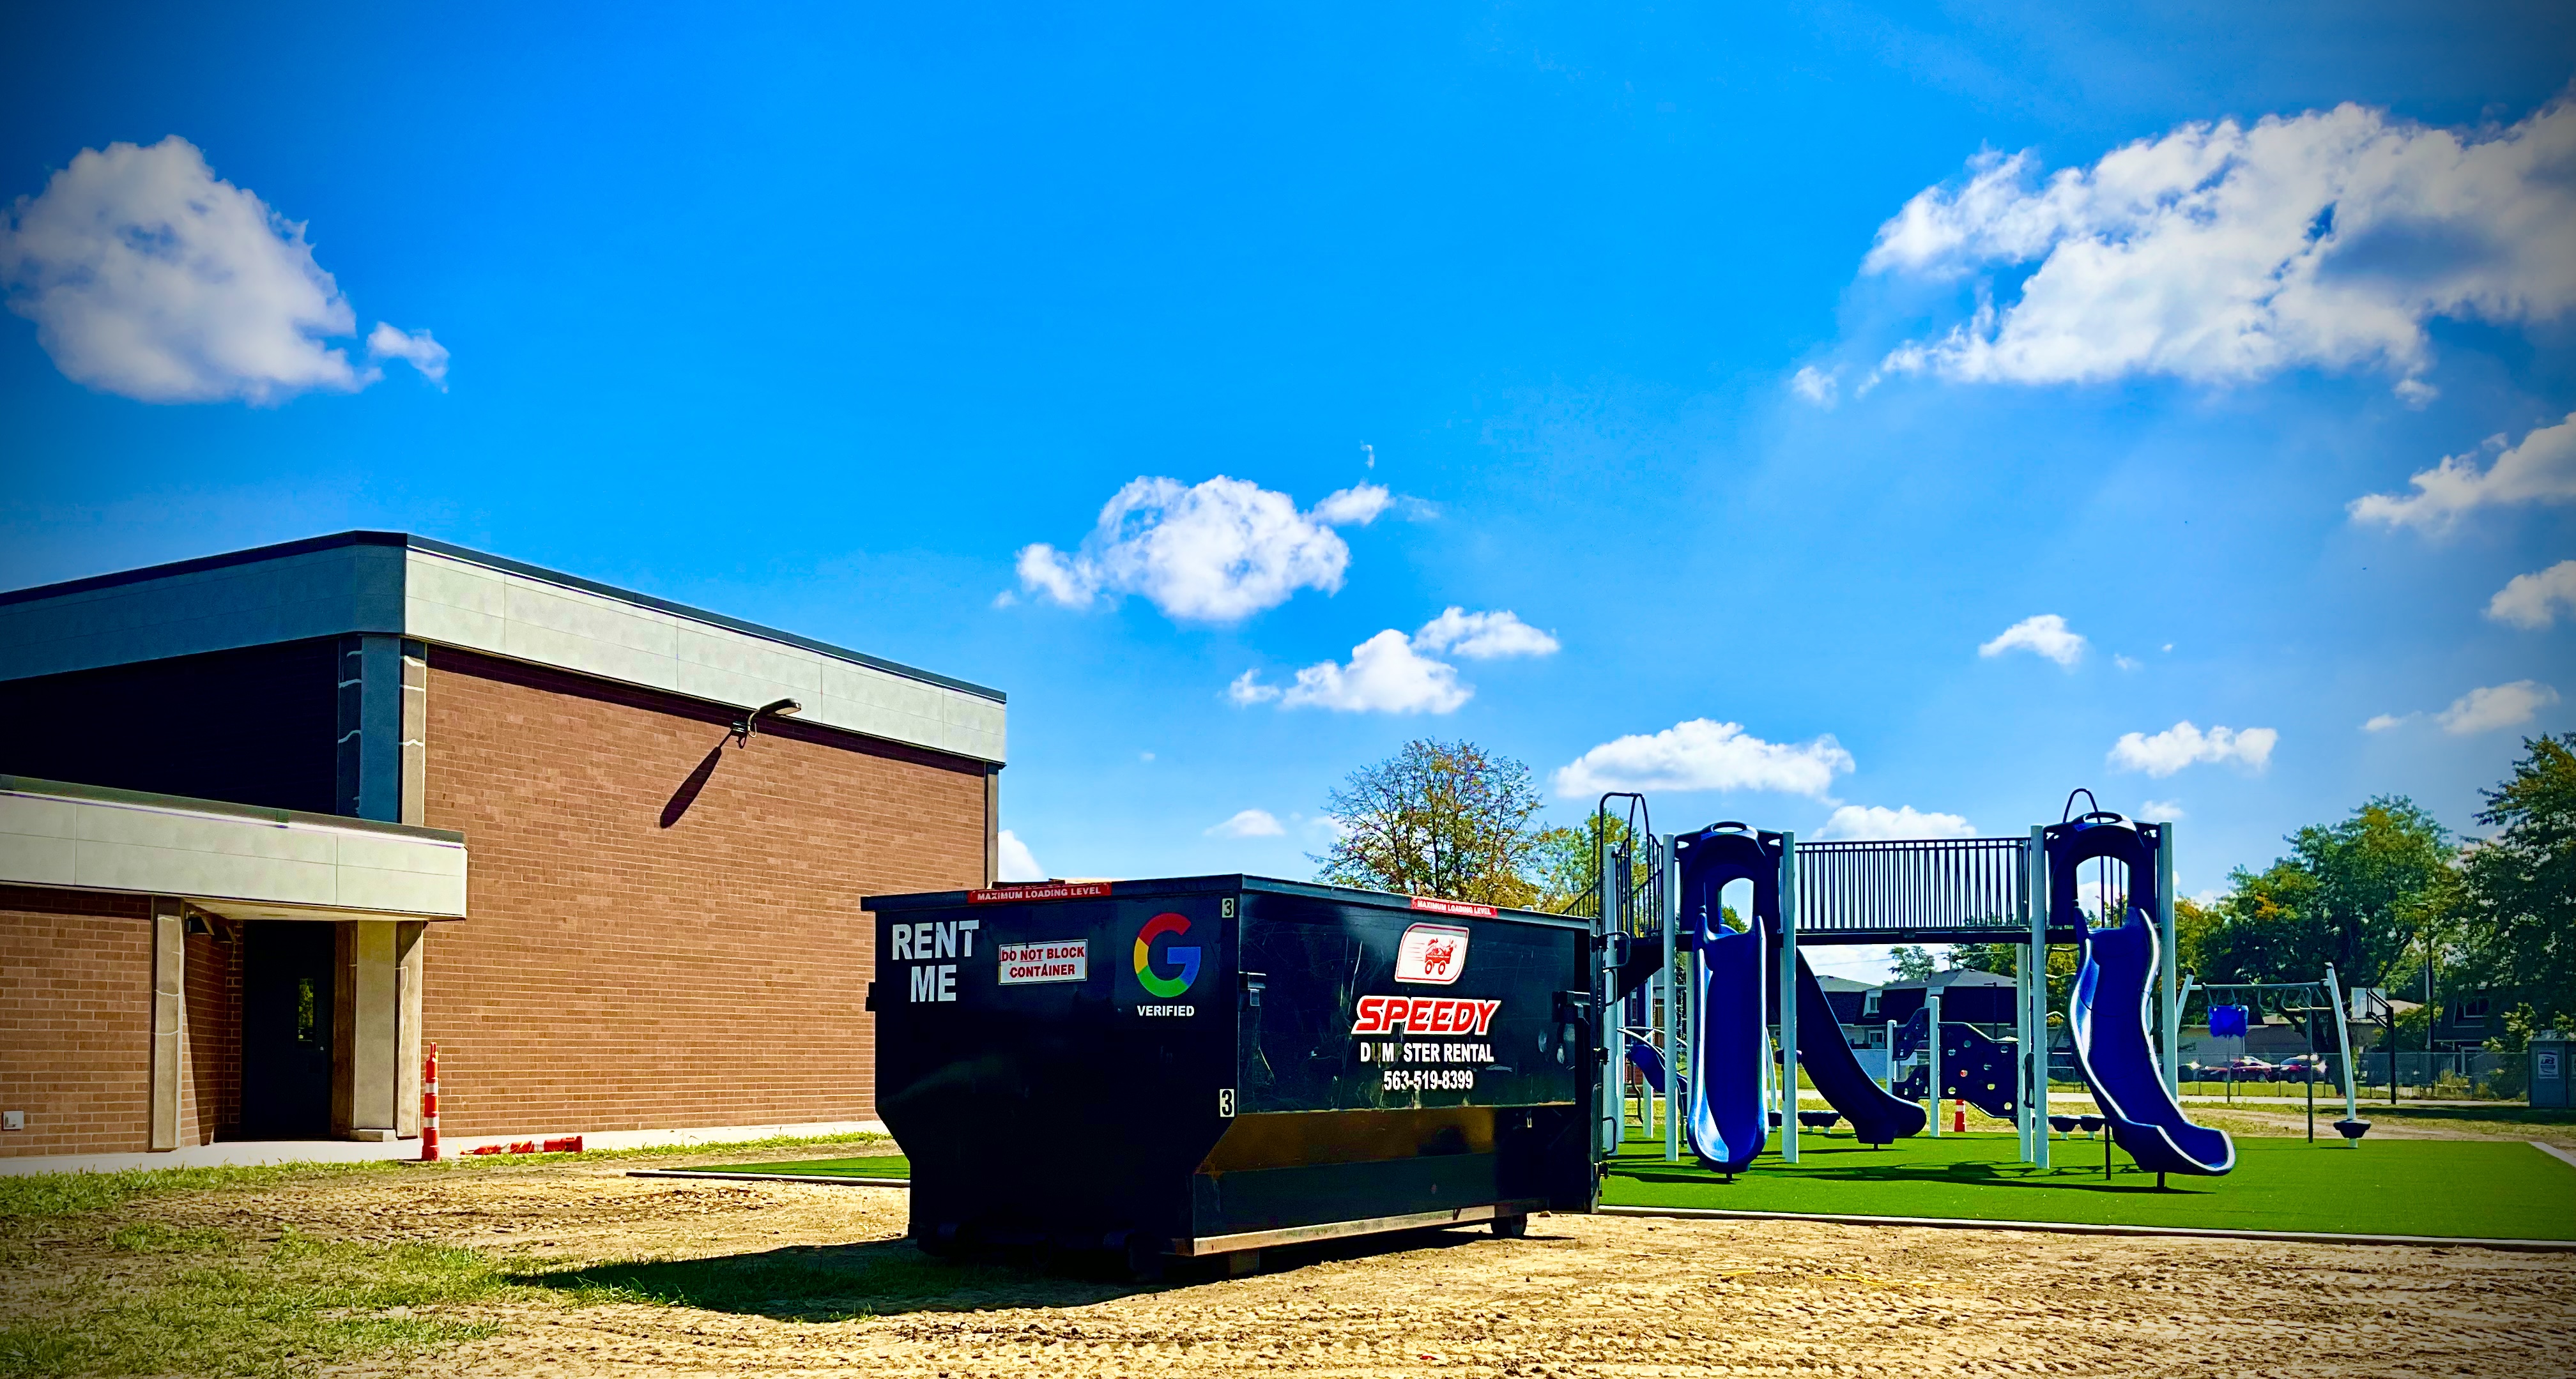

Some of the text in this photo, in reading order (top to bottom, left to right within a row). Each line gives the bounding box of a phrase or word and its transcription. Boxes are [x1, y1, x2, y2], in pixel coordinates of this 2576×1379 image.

[977, 887, 1101, 900] MAXIMUM LOADING LEVEL
[1223, 899, 1232, 916] 3
[1417, 900, 1491, 915] MAXIMUM LOADING LEVEL
[893, 920, 979, 960] RENT
[1002, 947, 1085, 961] DO NOT BLOCK
[1133, 912, 1201, 998] G
[1009, 964, 1075, 978] CONTAINER
[911, 964, 956, 1002] ME
[1137, 1005, 1195, 1016] VERIFIED
[1351, 995, 1501, 1035] SPEEDY
[1443, 1043, 1494, 1062] RENTAL
[1384, 1070, 1473, 1090] 563-519-8399
[1222, 1090, 1232, 1115] 3
